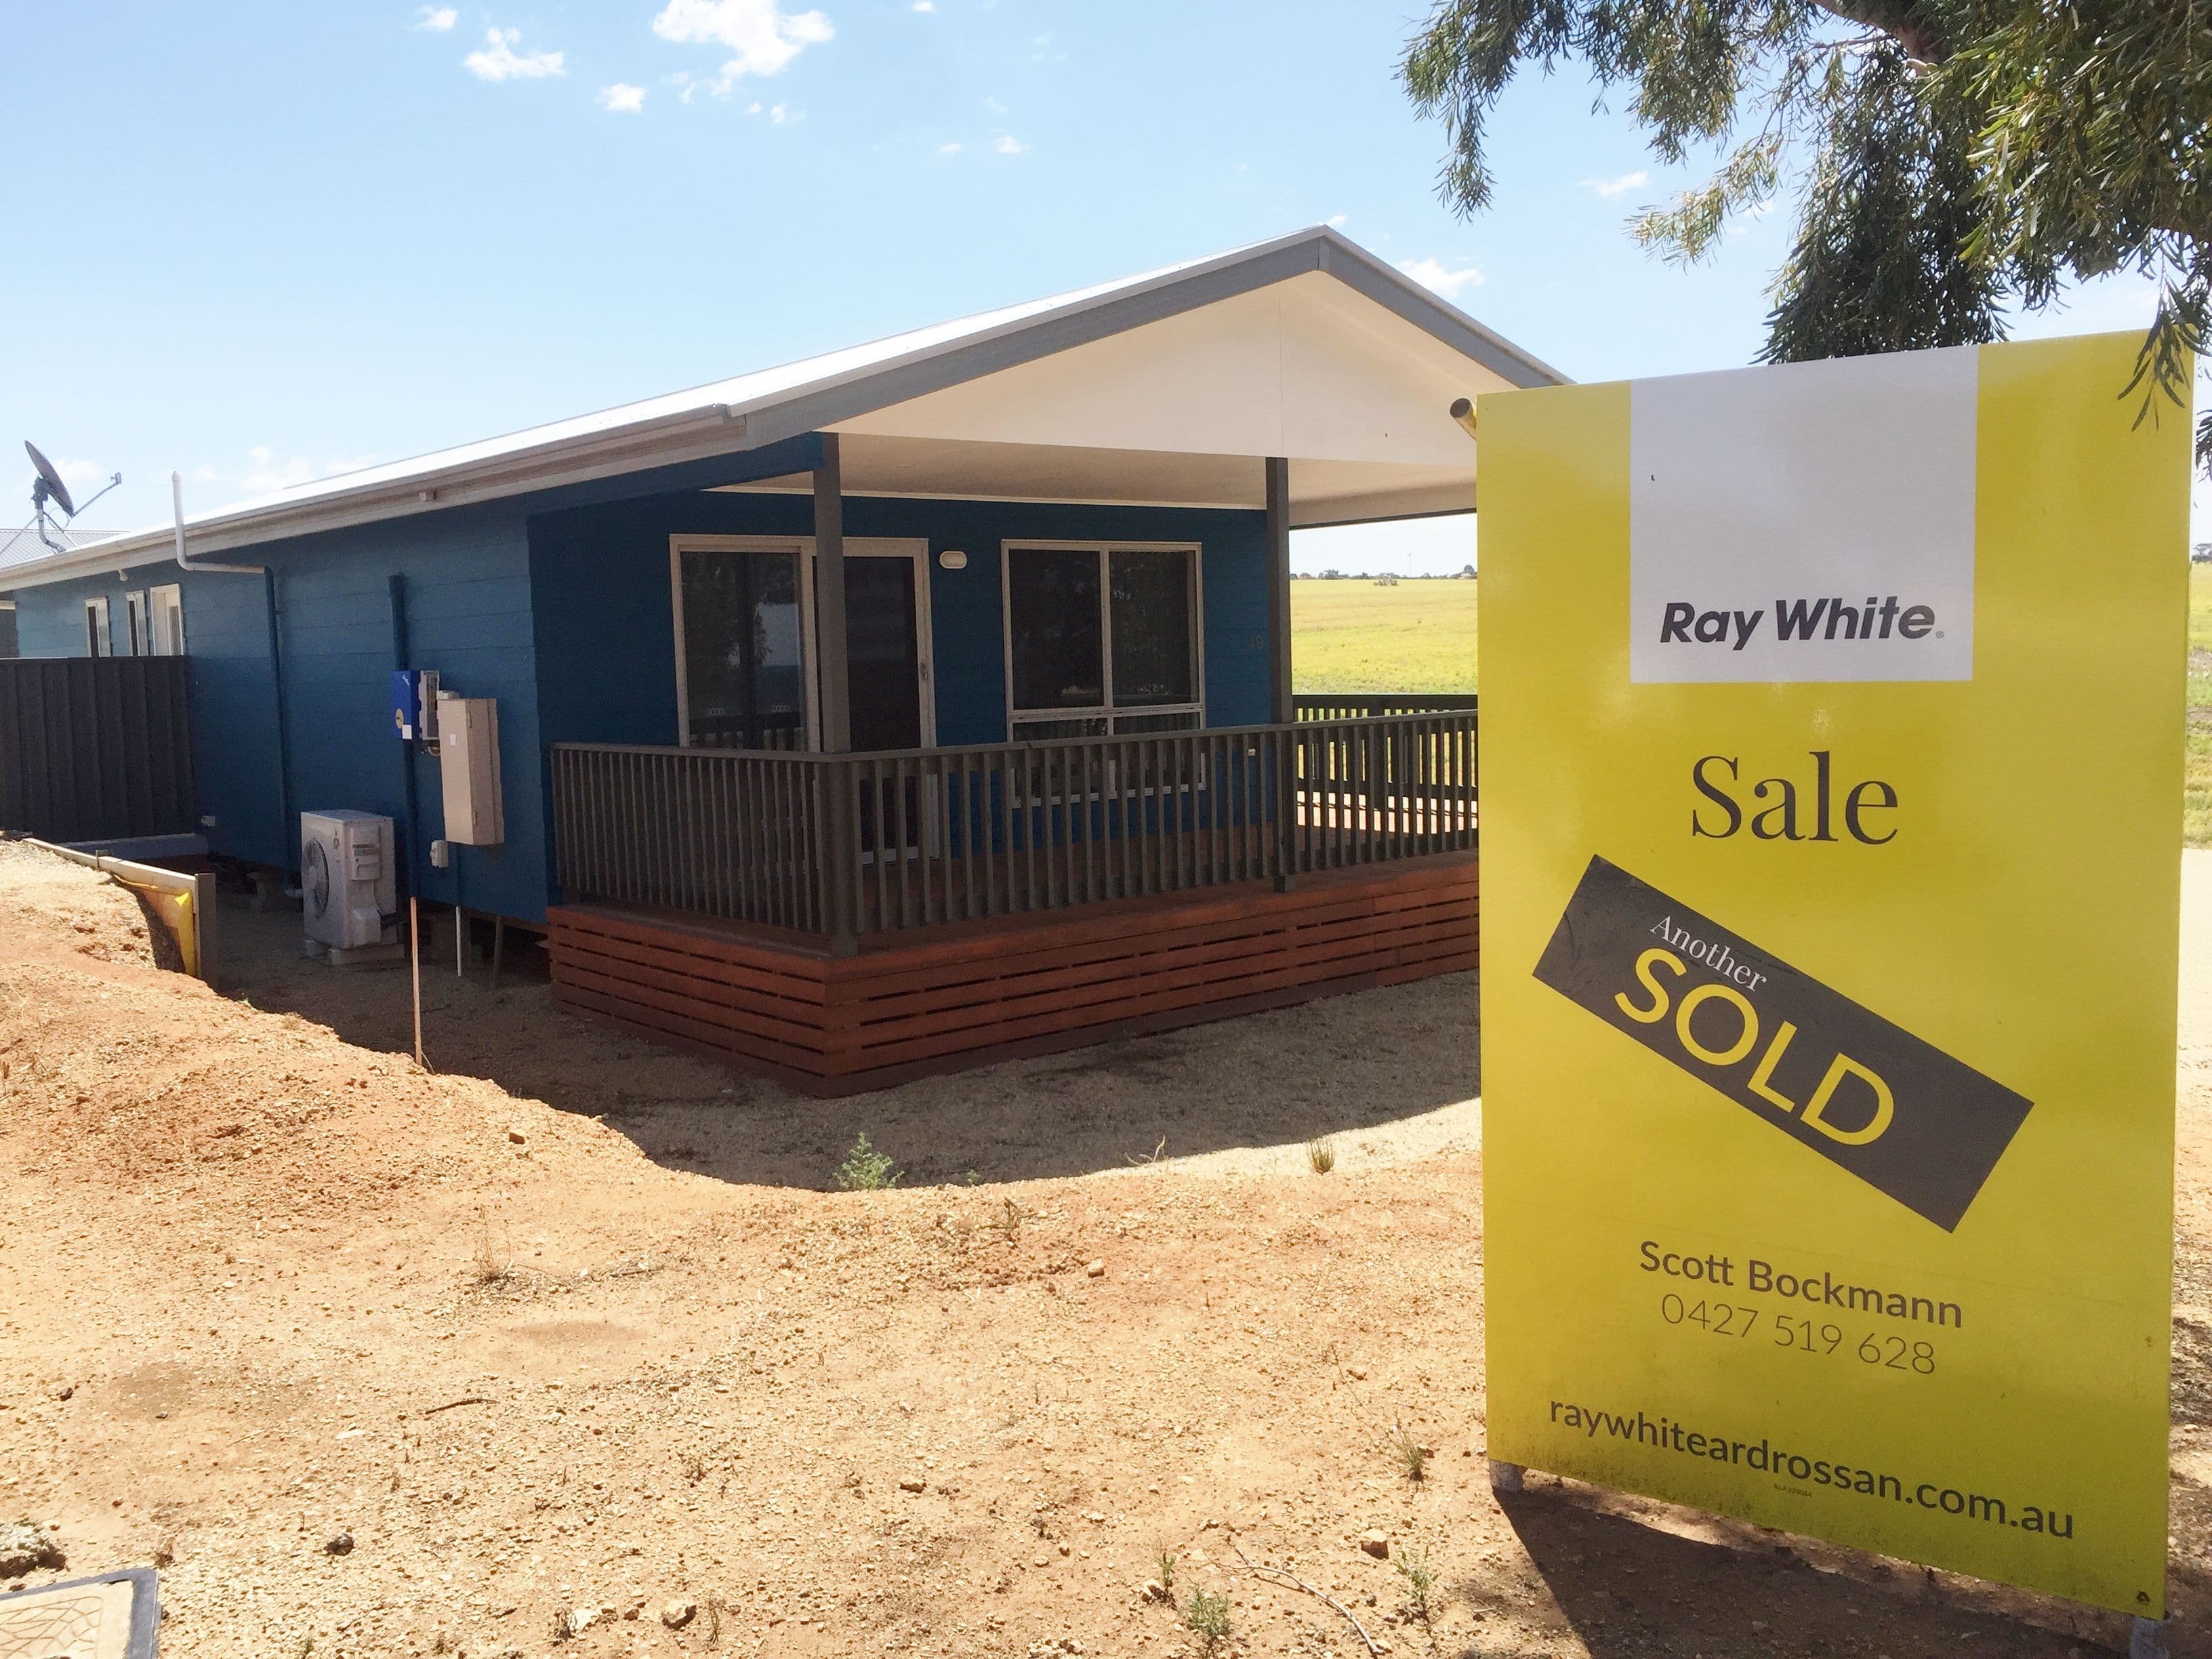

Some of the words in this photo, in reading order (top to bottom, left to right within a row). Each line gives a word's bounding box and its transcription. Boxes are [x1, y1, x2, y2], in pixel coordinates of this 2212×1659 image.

[1659, 602, 1765, 651] Ray
[1692, 750, 1899, 845] Sale
[1649, 916, 1767, 993] Another
[1614, 948, 1894, 1146] SOLD
[1639, 1240, 1735, 1286] Scott
[1748, 1258, 1963, 1329] Bockmann
[1661, 1293, 1759, 1338] 0427
[1774, 1315, 1843, 1355] 519
[1858, 1332, 1936, 1375] 628
[1550, 1399, 2074, 1540] raywhiteardrossan.com.au
